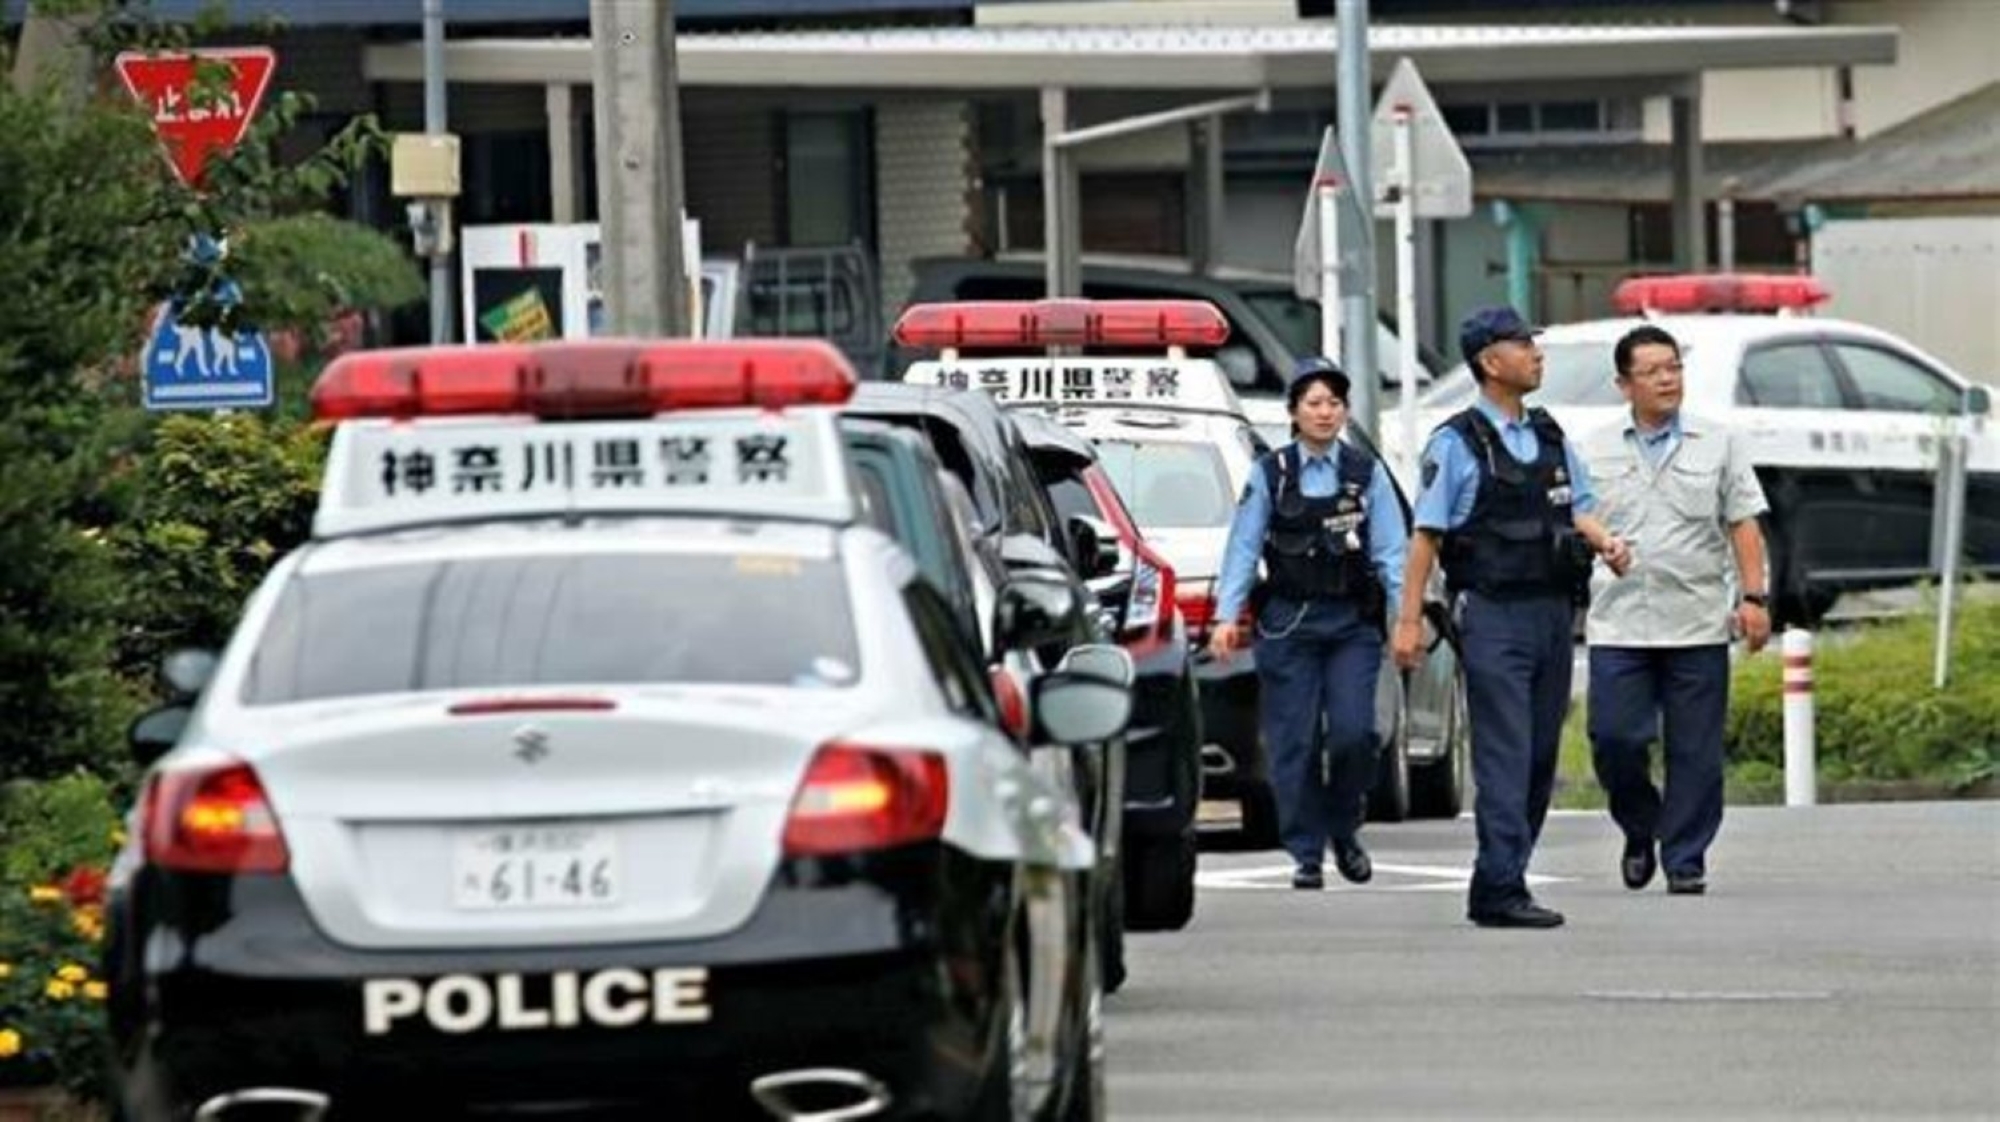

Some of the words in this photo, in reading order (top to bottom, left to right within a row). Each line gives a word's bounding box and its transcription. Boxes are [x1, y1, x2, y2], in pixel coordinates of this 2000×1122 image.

[381, 434, 791, 496] 神奈川県警察
[490, 858, 609, 901] 61-46
[363, 966, 712, 1034] POLICE
